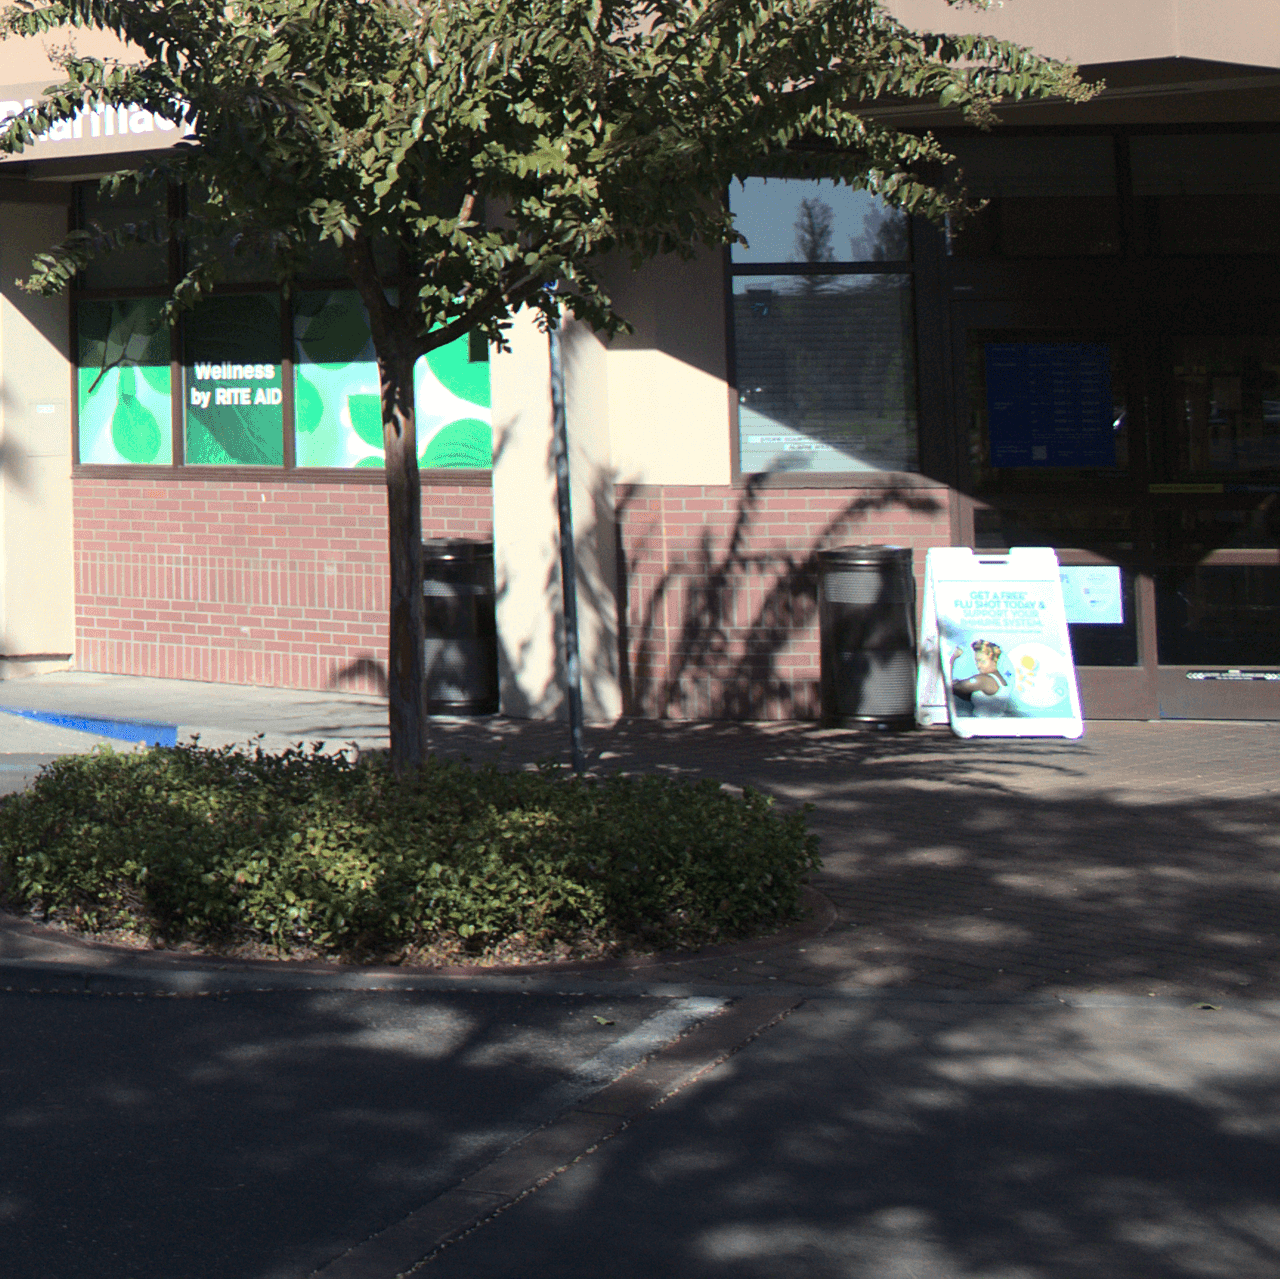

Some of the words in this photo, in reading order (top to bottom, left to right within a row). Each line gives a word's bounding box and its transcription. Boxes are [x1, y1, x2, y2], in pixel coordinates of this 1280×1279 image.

[194, 361, 276, 380] Wellness
[190, 386, 212, 408] by
[215, 387, 252, 405] RITE
[253, 387, 283, 405] AID
[970, 591, 990, 600] GET
[954, 600, 972, 609] FLU
[975, 600, 1001, 609] SHOT
[1003, 600, 1036, 609] TODAY
